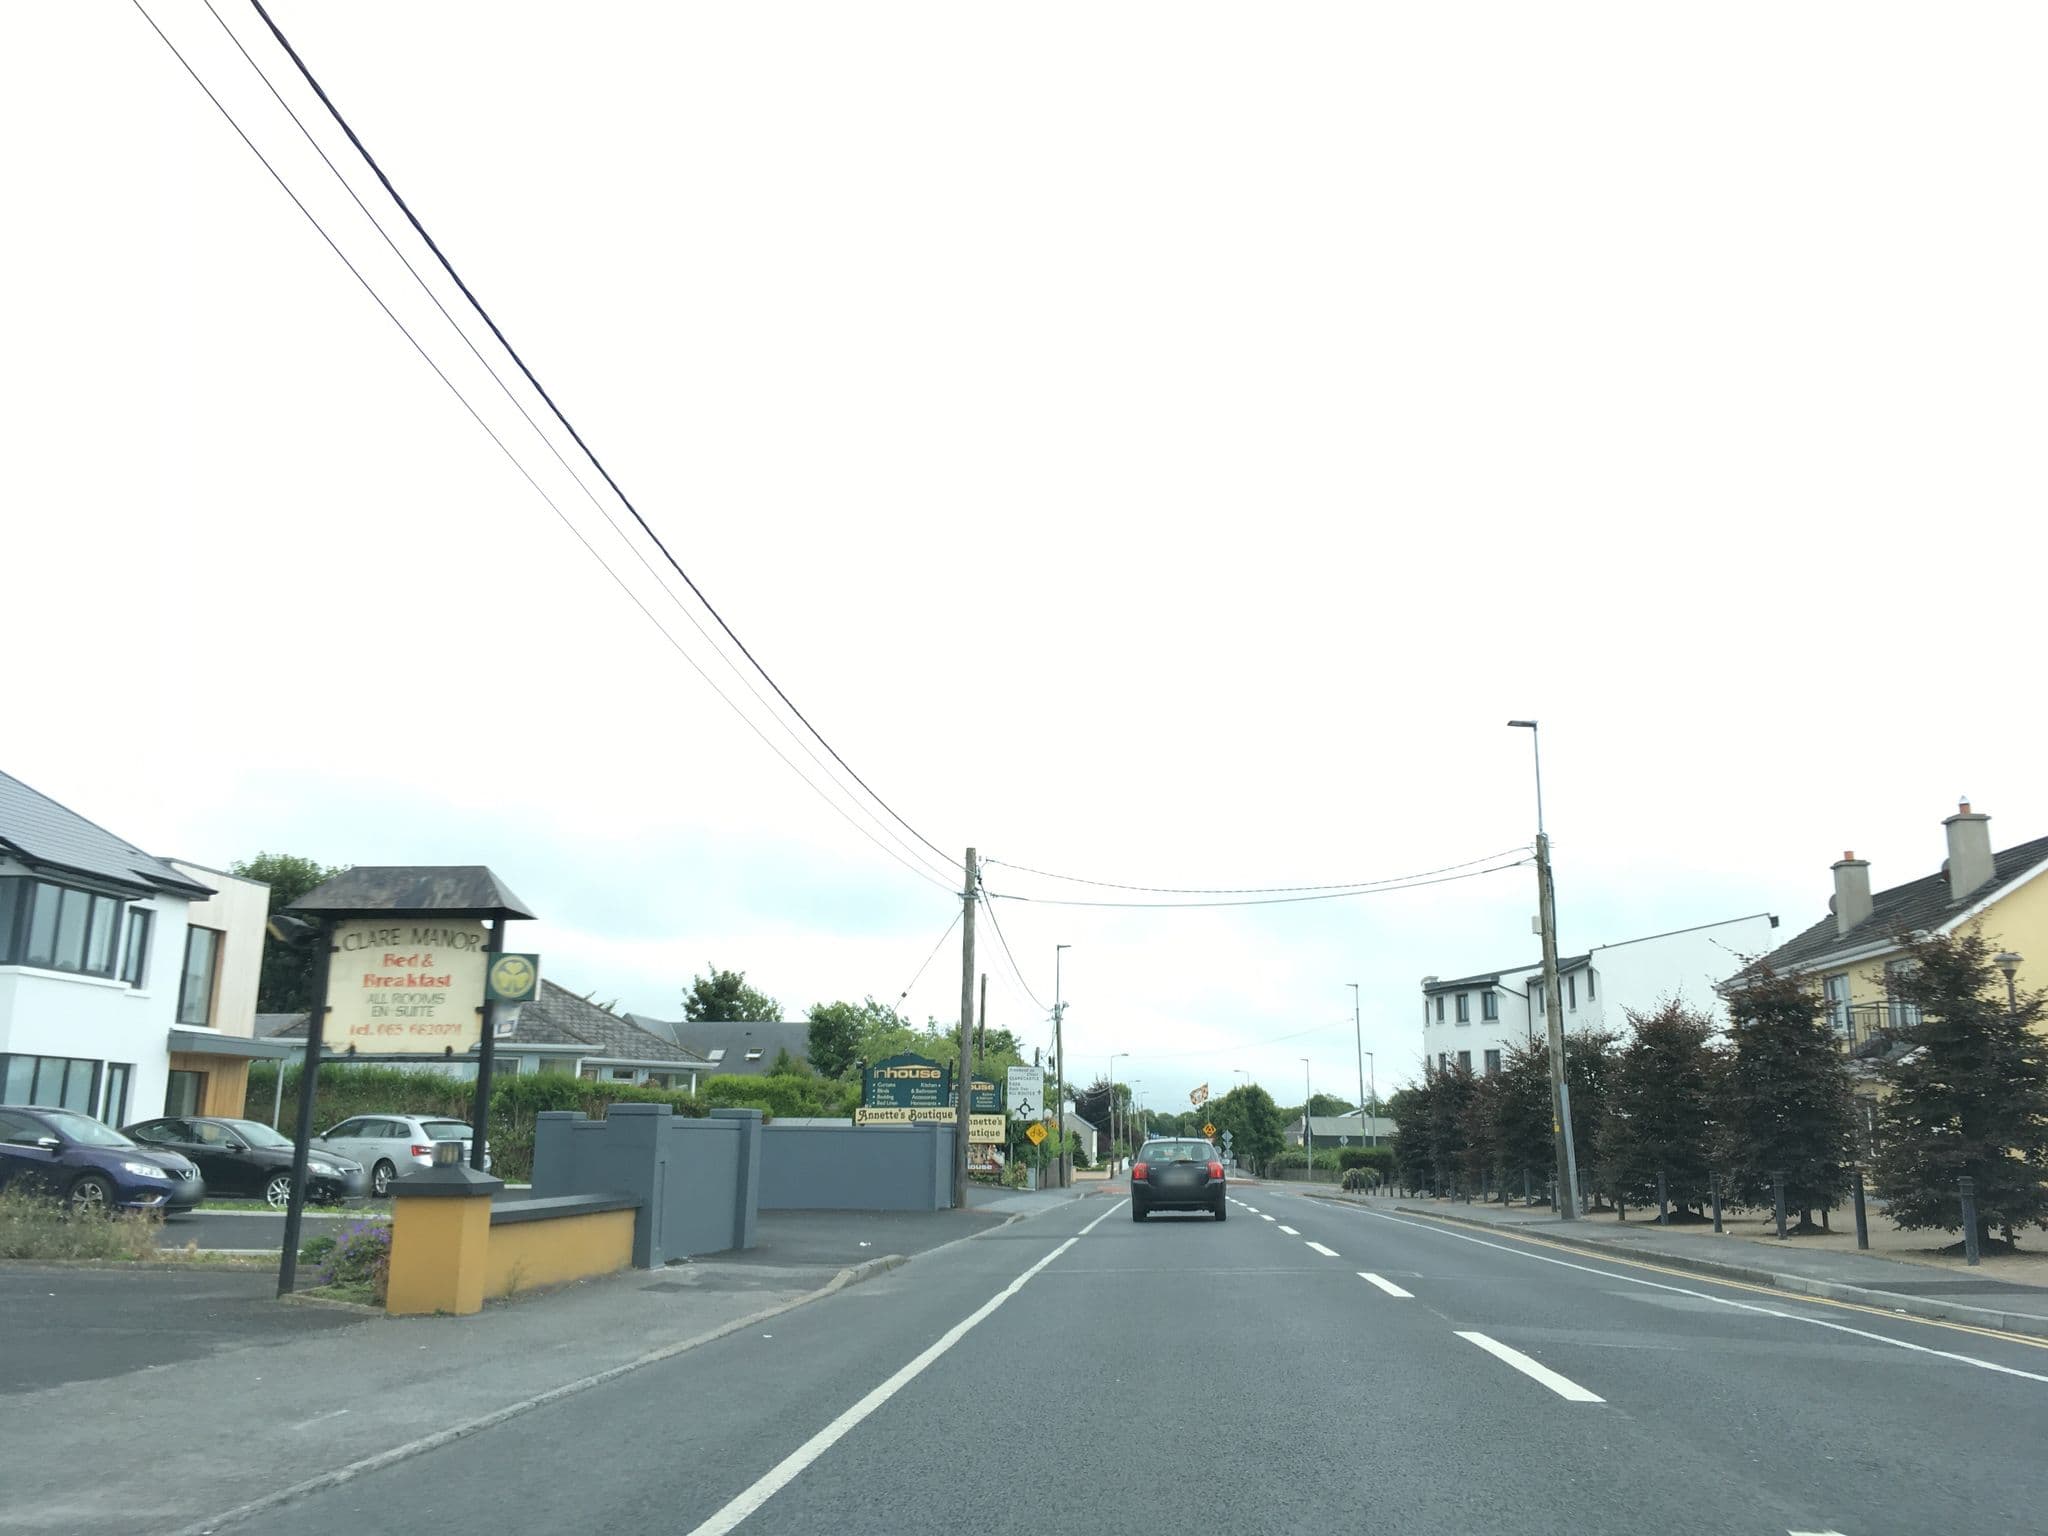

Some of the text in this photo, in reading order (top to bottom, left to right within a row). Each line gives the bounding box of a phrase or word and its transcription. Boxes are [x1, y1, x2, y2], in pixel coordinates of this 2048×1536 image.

[342, 928, 481, 953] CLARE MANOR
[383, 953, 434, 968] Bed &
[362, 972, 452, 988] Breakfast
[366, 992, 447, 1005] ALL ROOMS
[371, 1005, 436, 1018] EN SUITE
[873, 1066, 942, 1079] inhouse
[857, 1108, 953, 1122] Annette's Boutique
